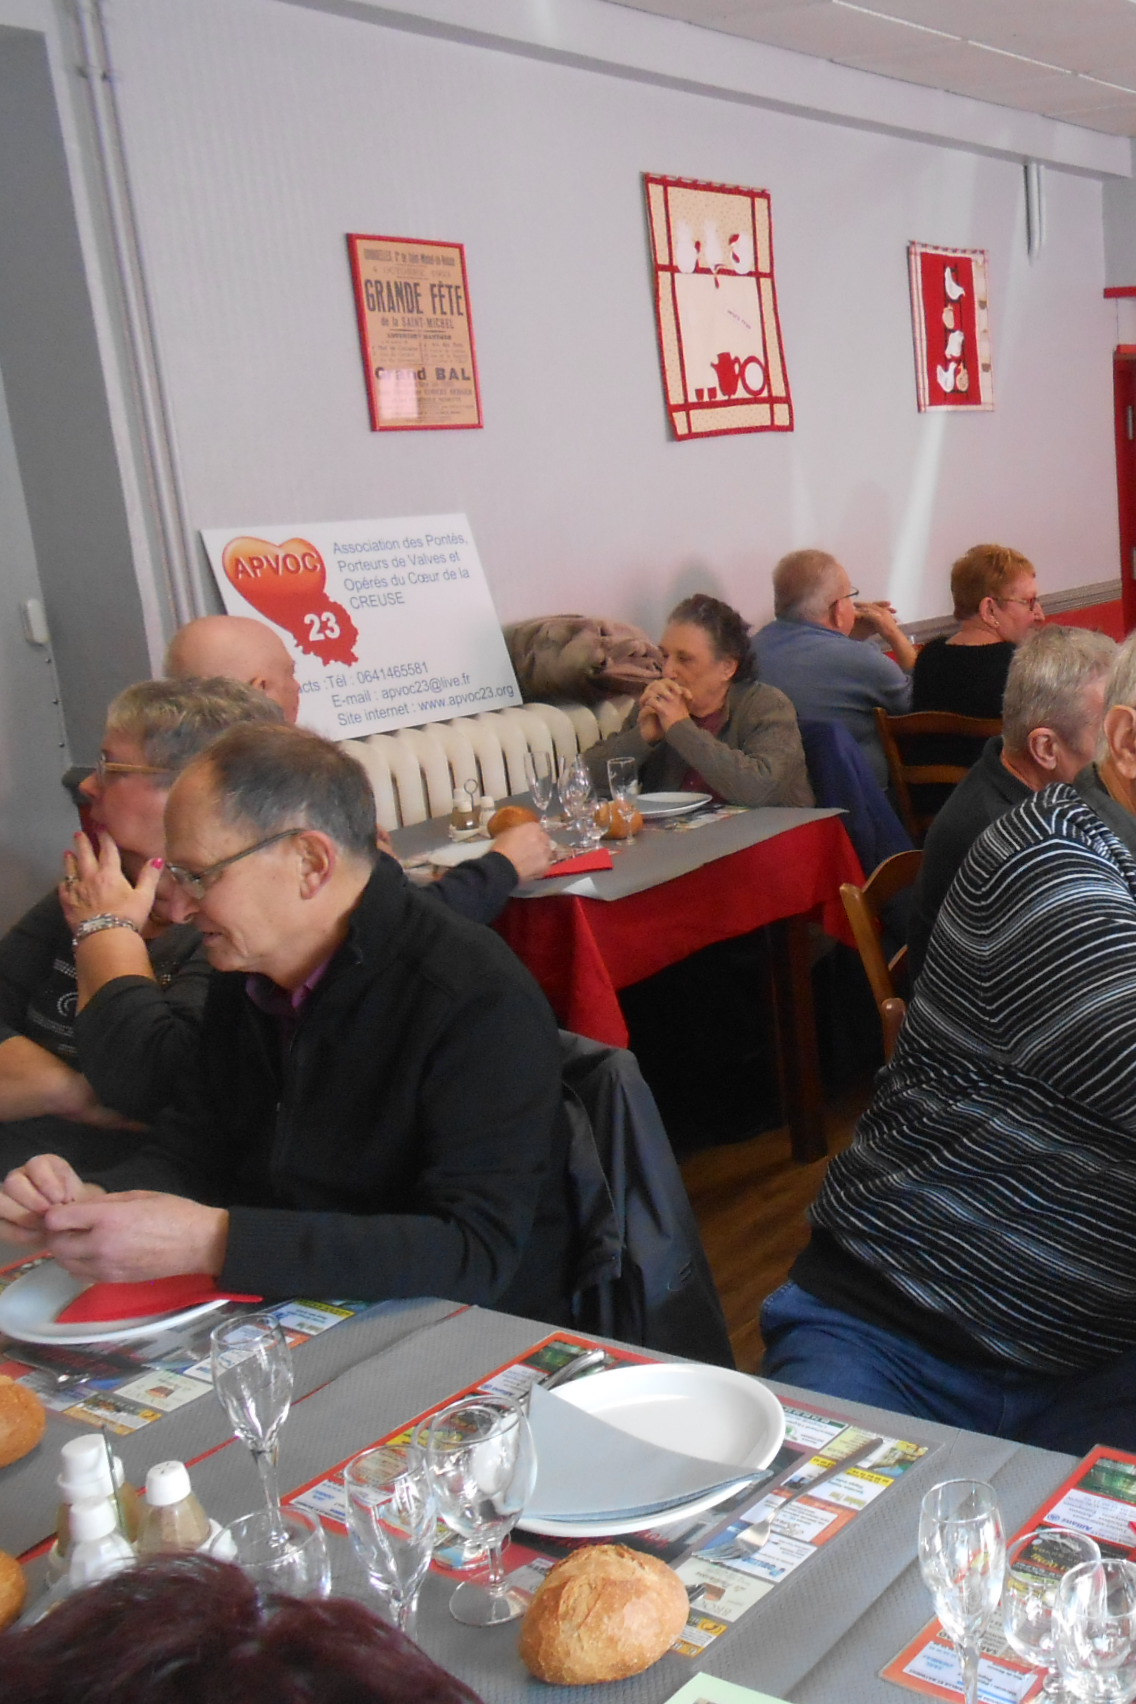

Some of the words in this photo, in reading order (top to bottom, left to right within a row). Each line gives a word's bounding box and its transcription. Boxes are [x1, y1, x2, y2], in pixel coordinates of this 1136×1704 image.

[364, 279, 424, 314] GRANDE
[435, 367, 471, 381] BAL
[333, 538, 400, 554] Association
[402, 536, 423, 549] des
[235, 551, 321, 579] APVOC
[337, 557, 389, 572] Porteurs
[392, 556, 406, 568] de
[407, 553, 446, 566] Valves
[449, 552, 460, 562] et
[344, 575, 388, 592] Opérés
[391, 574, 405, 586] du
[443, 569, 457, 581] de
[459, 567, 470, 579] la
[350, 592, 405, 609] CREUSE
[304, 612, 341, 641] 23
[357, 662, 428, 684] 0641465581
[332, 690, 371, 708] E-mail
[381, 673, 471, 701] apvoc23@live.fr
[338, 712, 362, 726] Site
[364, 703, 409, 721] internet
[418, 685, 514, 710] www.apvoc23.org
